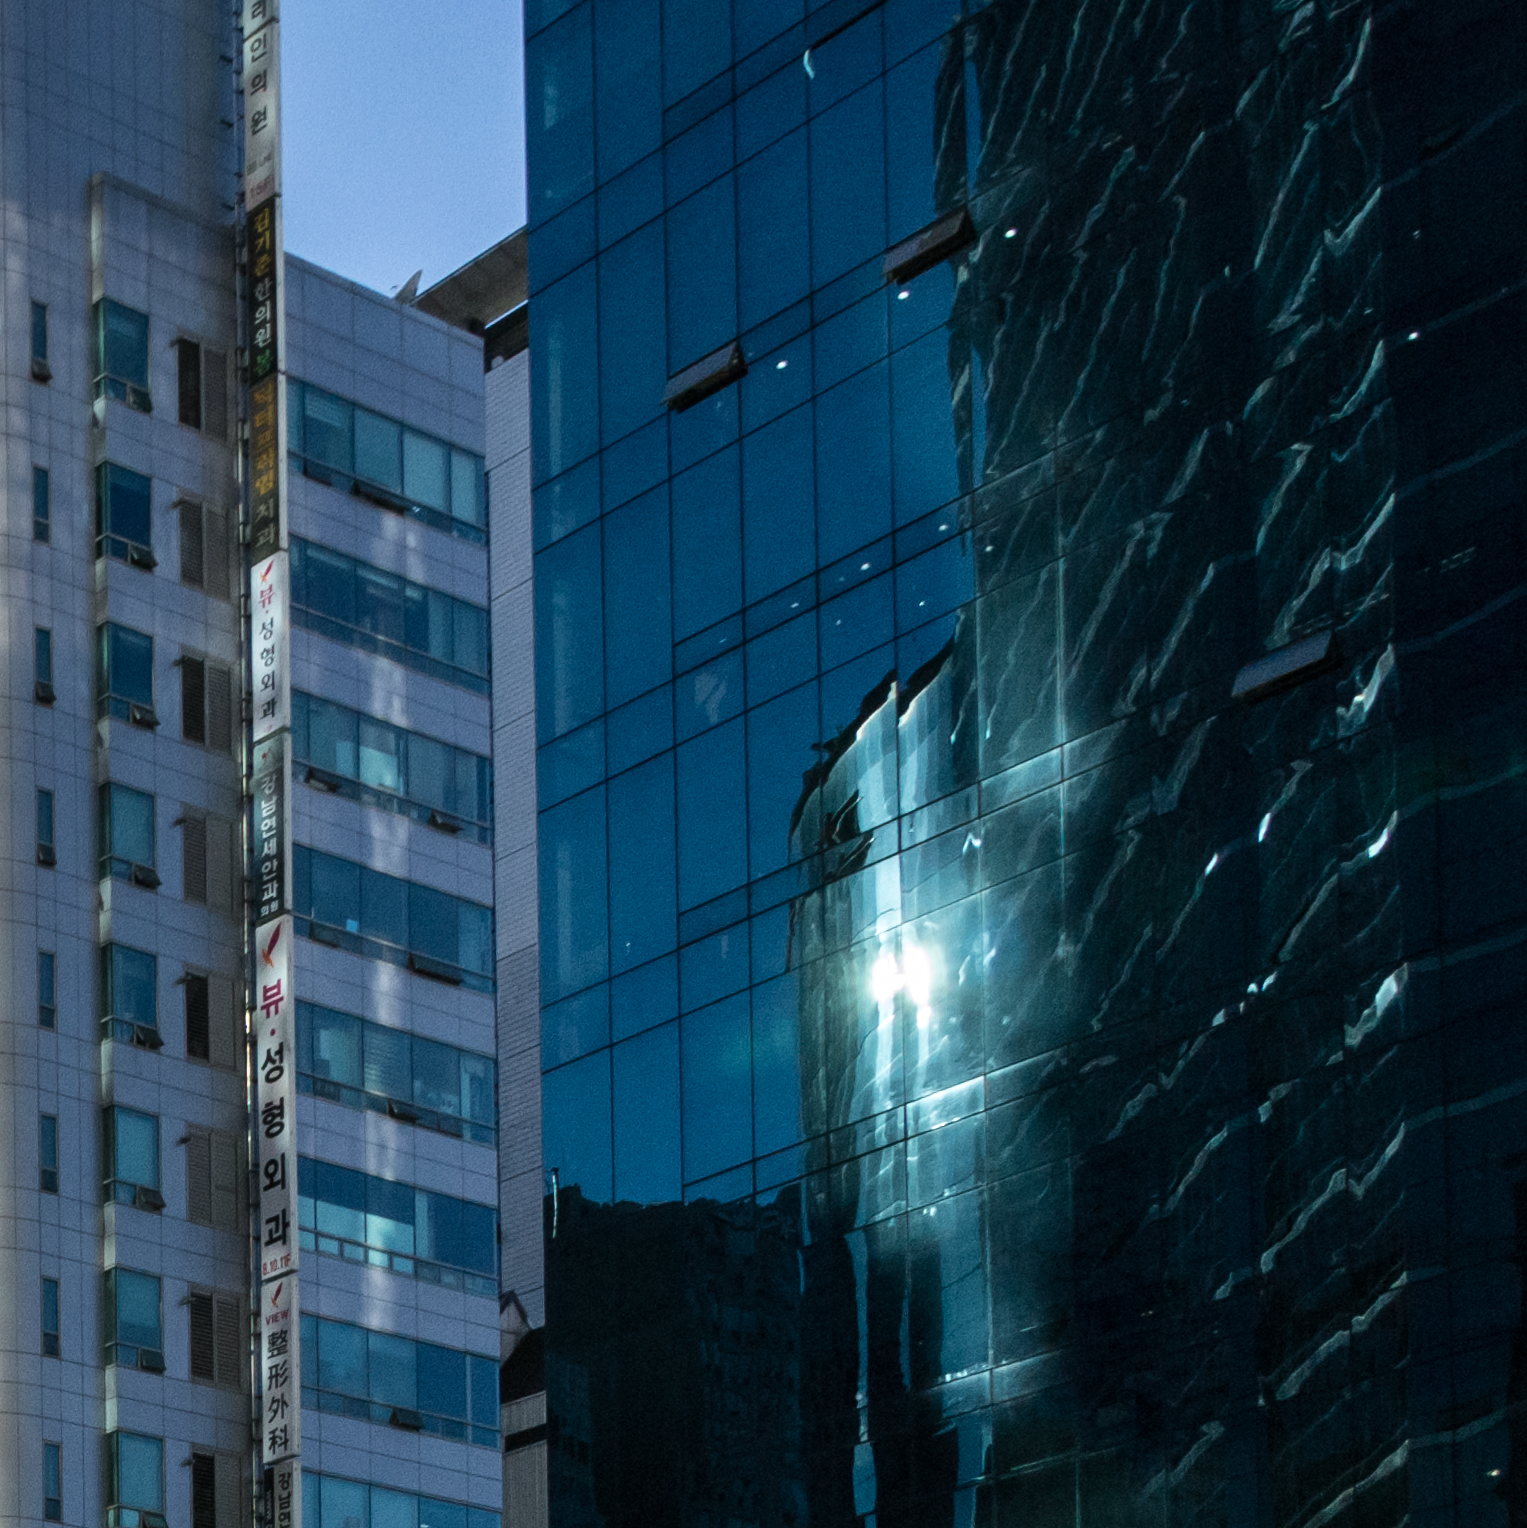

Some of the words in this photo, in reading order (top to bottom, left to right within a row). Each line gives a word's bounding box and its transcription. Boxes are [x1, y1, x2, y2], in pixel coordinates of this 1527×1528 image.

[265, 1309, 290, 1327] VIEW
[268, 1330, 290, 1456] 整形外科
